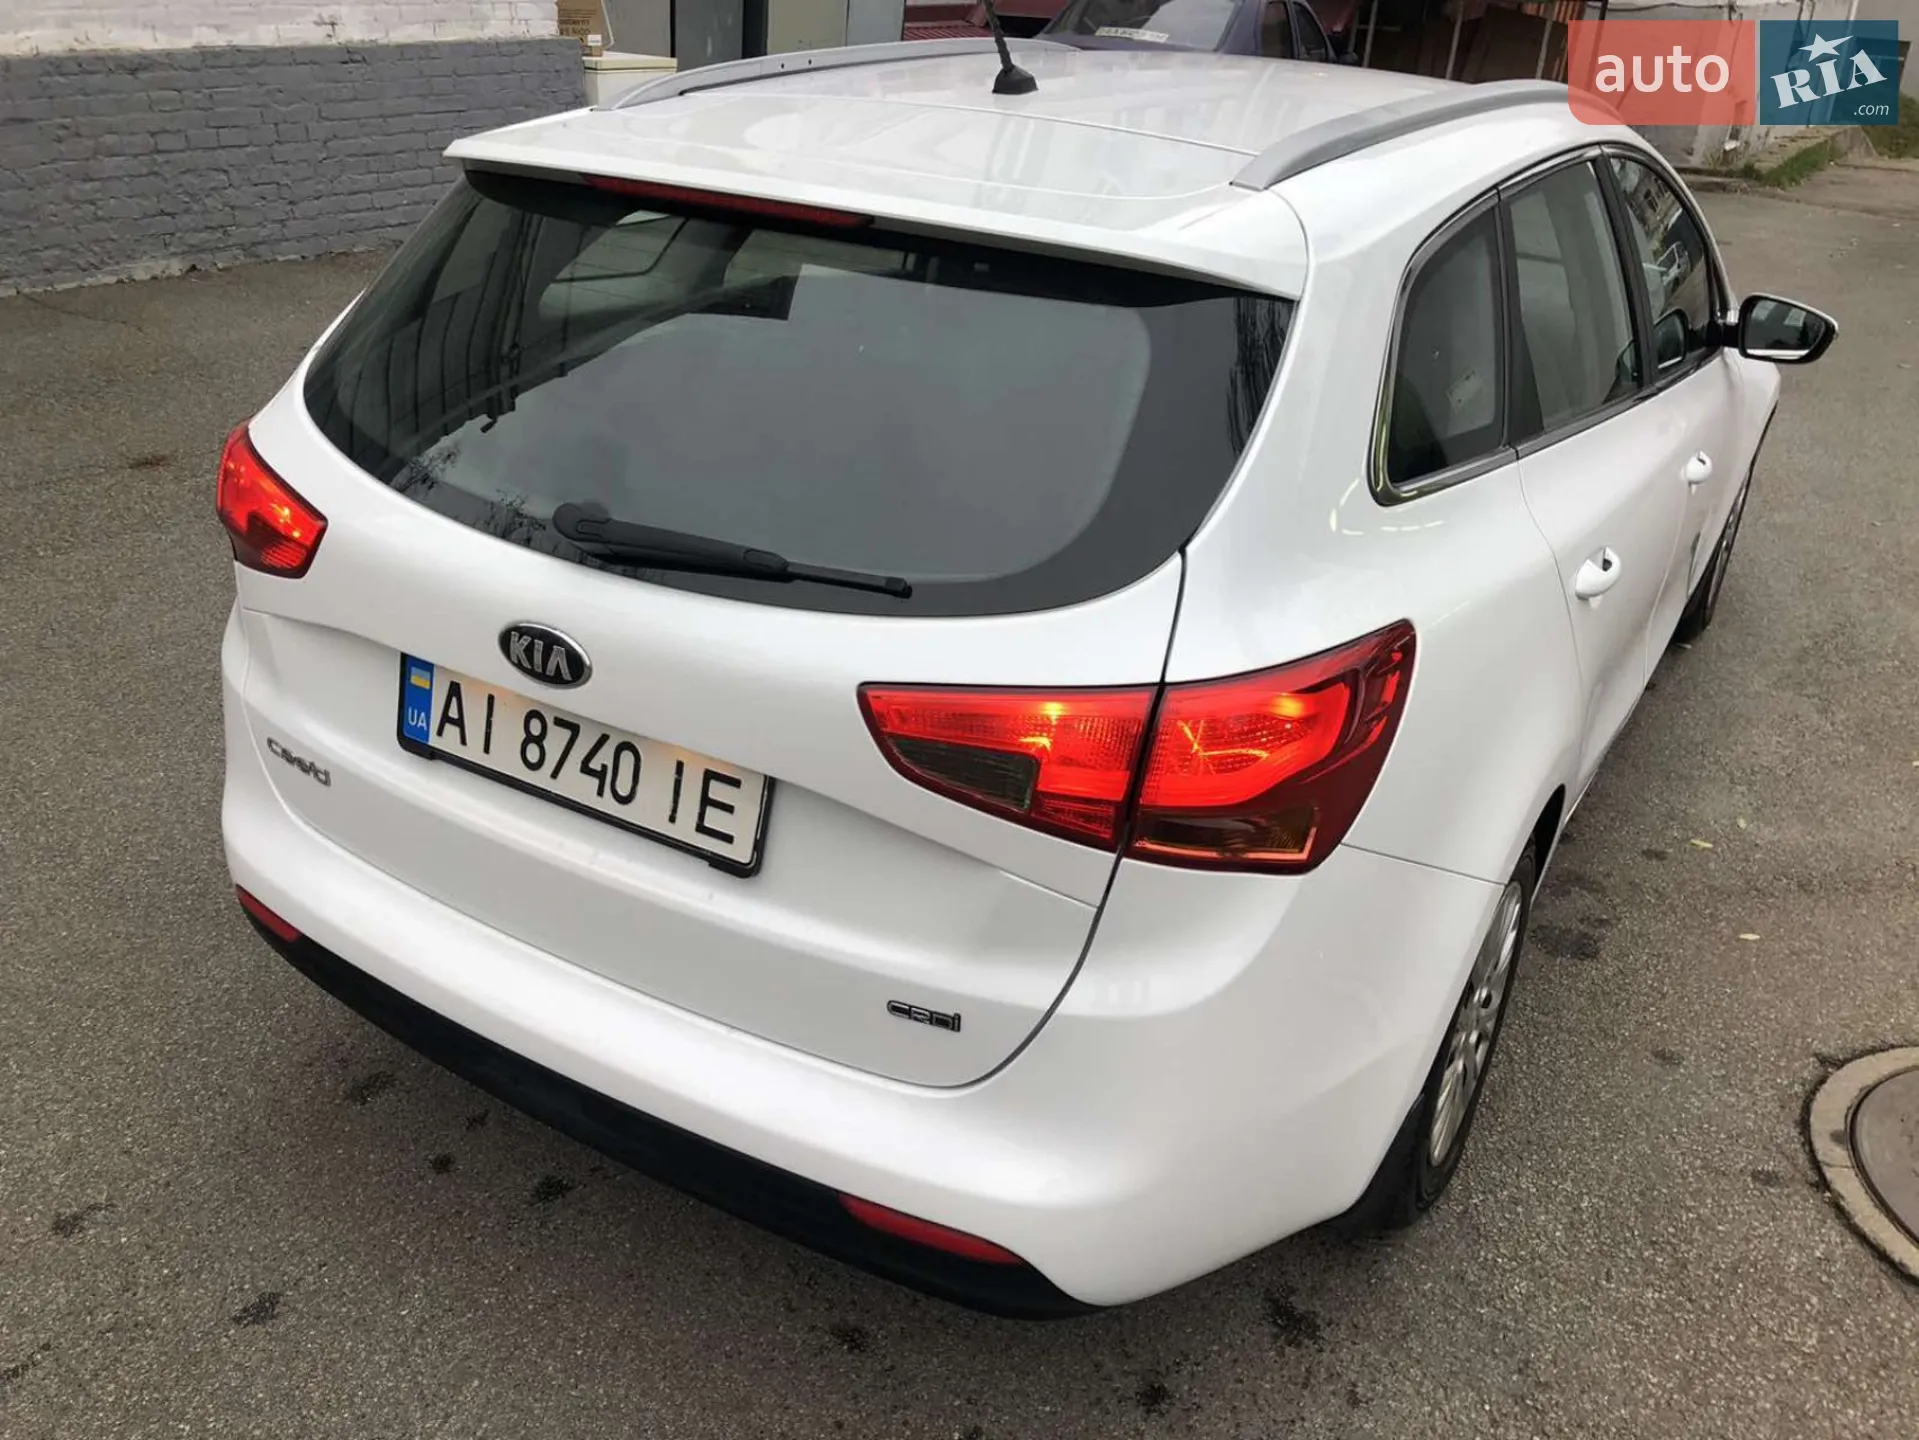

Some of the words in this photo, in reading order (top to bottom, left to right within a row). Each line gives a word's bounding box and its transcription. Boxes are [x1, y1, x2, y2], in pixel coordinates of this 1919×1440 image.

[509, 631, 573, 681] KIA
[408, 706, 428, 731] UA
[436, 680, 495, 755] AI
[520, 709, 642, 805] 8740
[668, 760, 743, 845] IE
